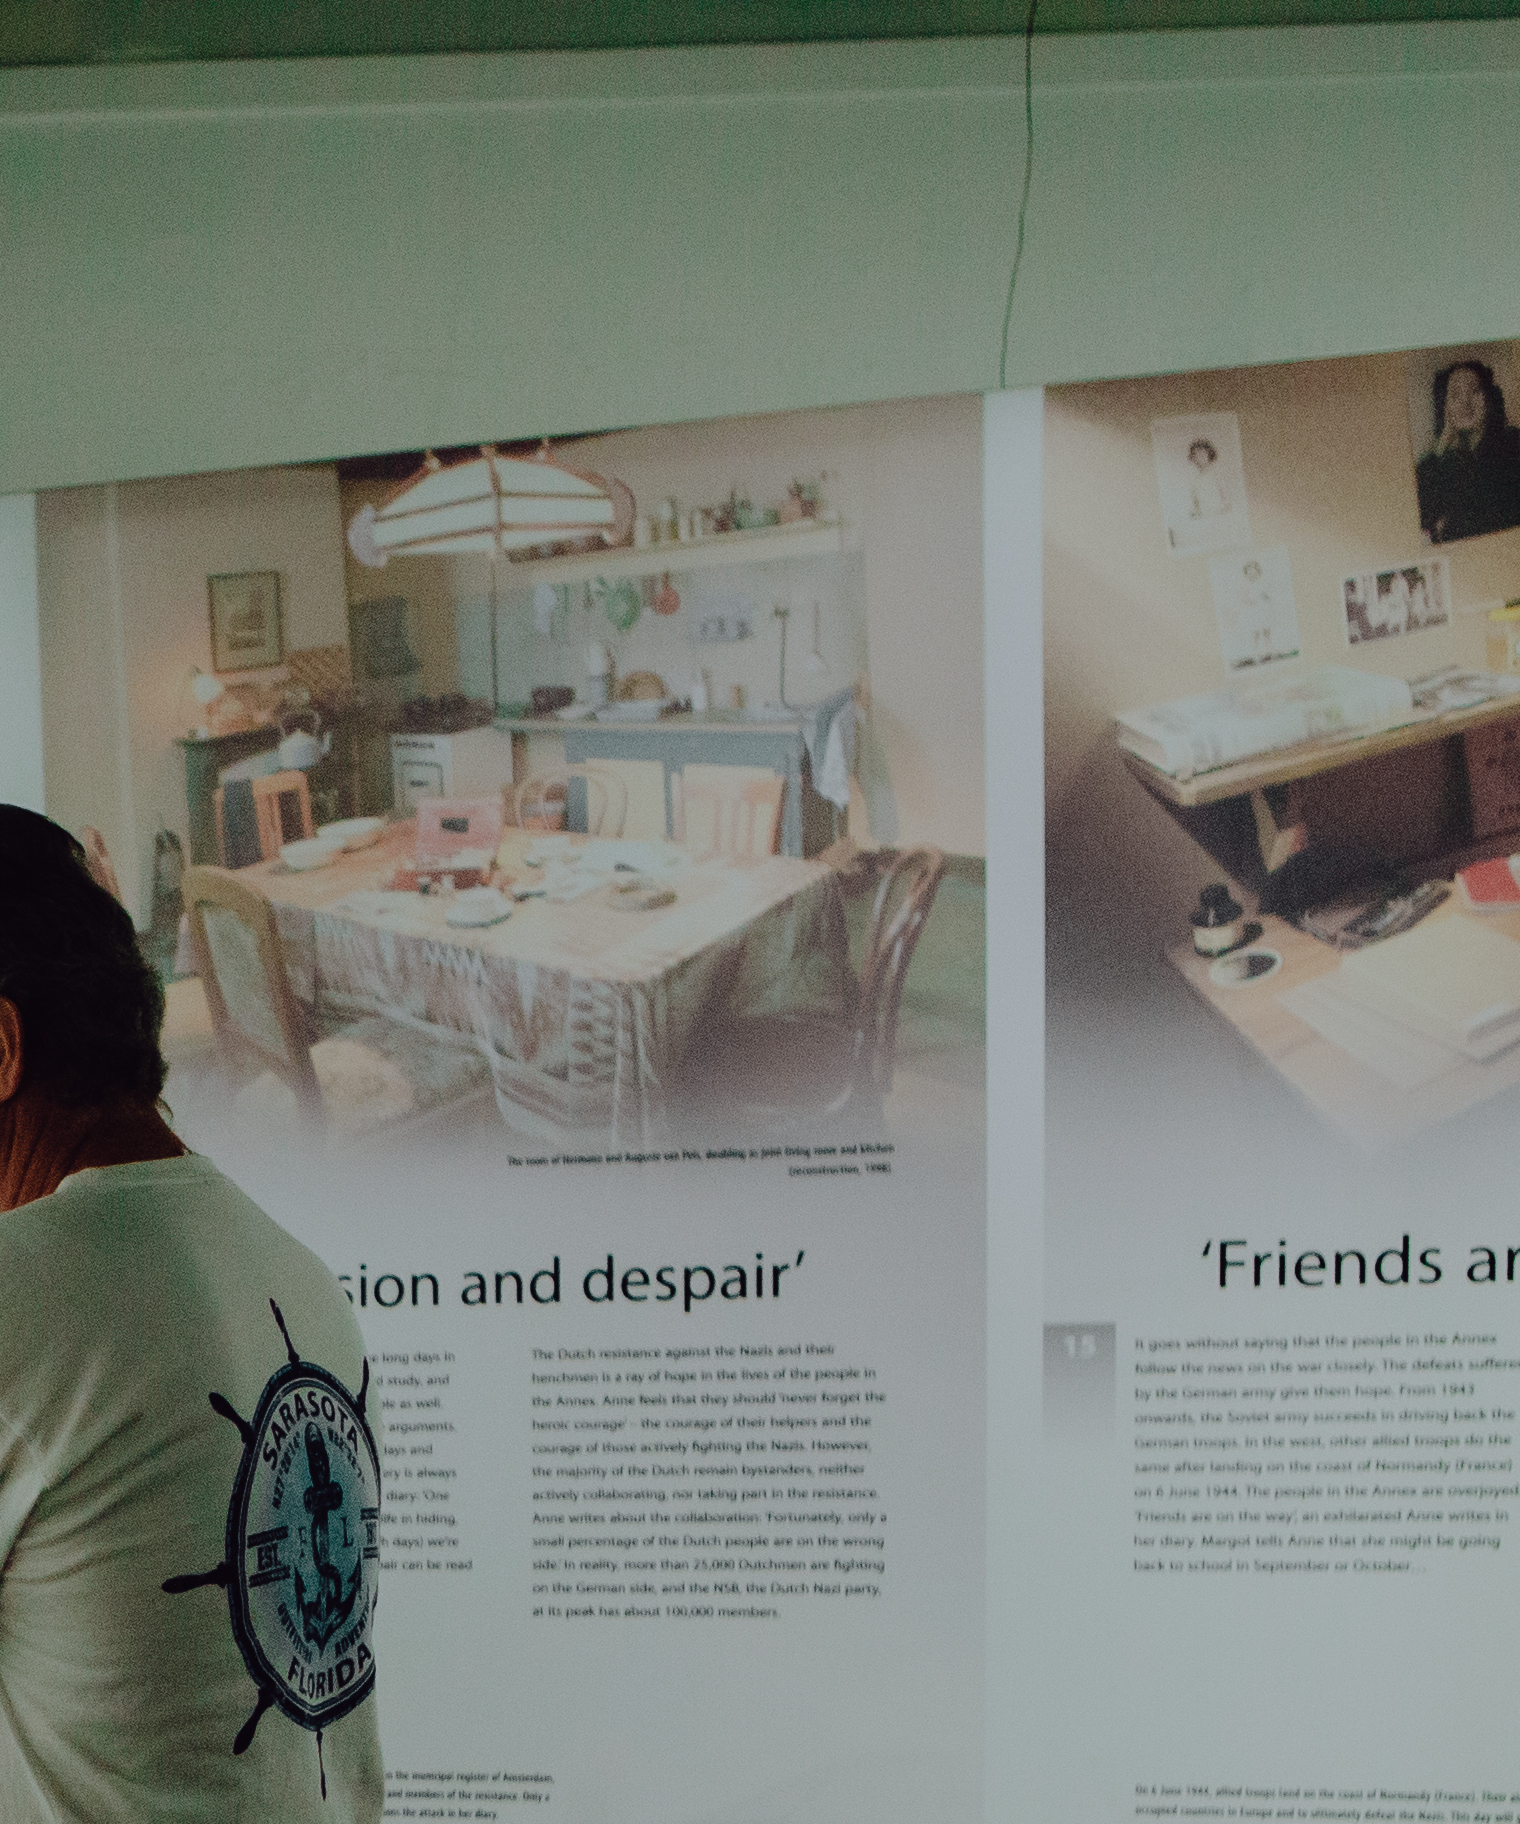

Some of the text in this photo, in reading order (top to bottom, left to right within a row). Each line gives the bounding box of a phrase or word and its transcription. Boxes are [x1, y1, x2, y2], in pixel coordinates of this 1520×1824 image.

[460, 1255, 561, 1305] and
[262, 1390, 359, 1471] SARASOTA
[287, 1641, 372, 1700] FLORIDA
